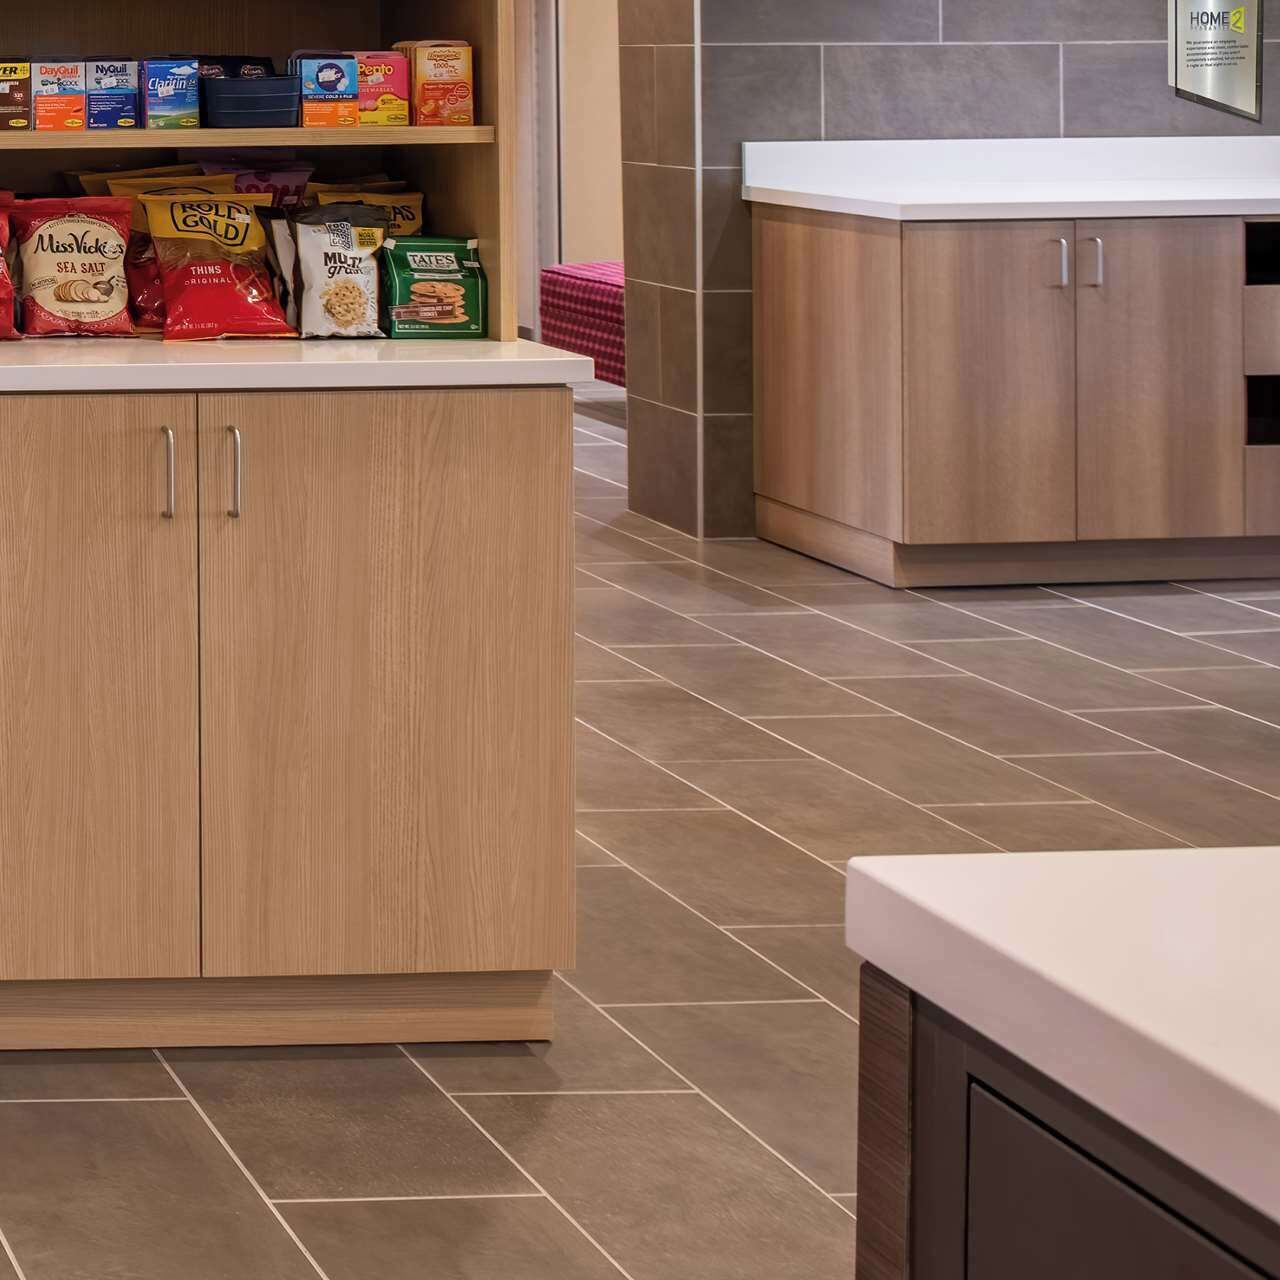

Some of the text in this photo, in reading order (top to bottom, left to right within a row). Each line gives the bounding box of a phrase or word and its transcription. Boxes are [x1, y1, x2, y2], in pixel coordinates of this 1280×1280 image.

[40, 65, 79, 76] DayQuil
[95, 64, 127, 76] NyQuil
[148, 77, 186, 90] Claritin
[180, 201, 238, 221] ROLD
[182, 214, 240, 241] GOLD
[34, 233, 74, 254] Miss
[409, 254, 455, 266] TATE'S
[56, 261, 106, 273] SEA SALT
[190, 265, 222, 275] THINS
[184, 277, 232, 286] ORIGINAL
